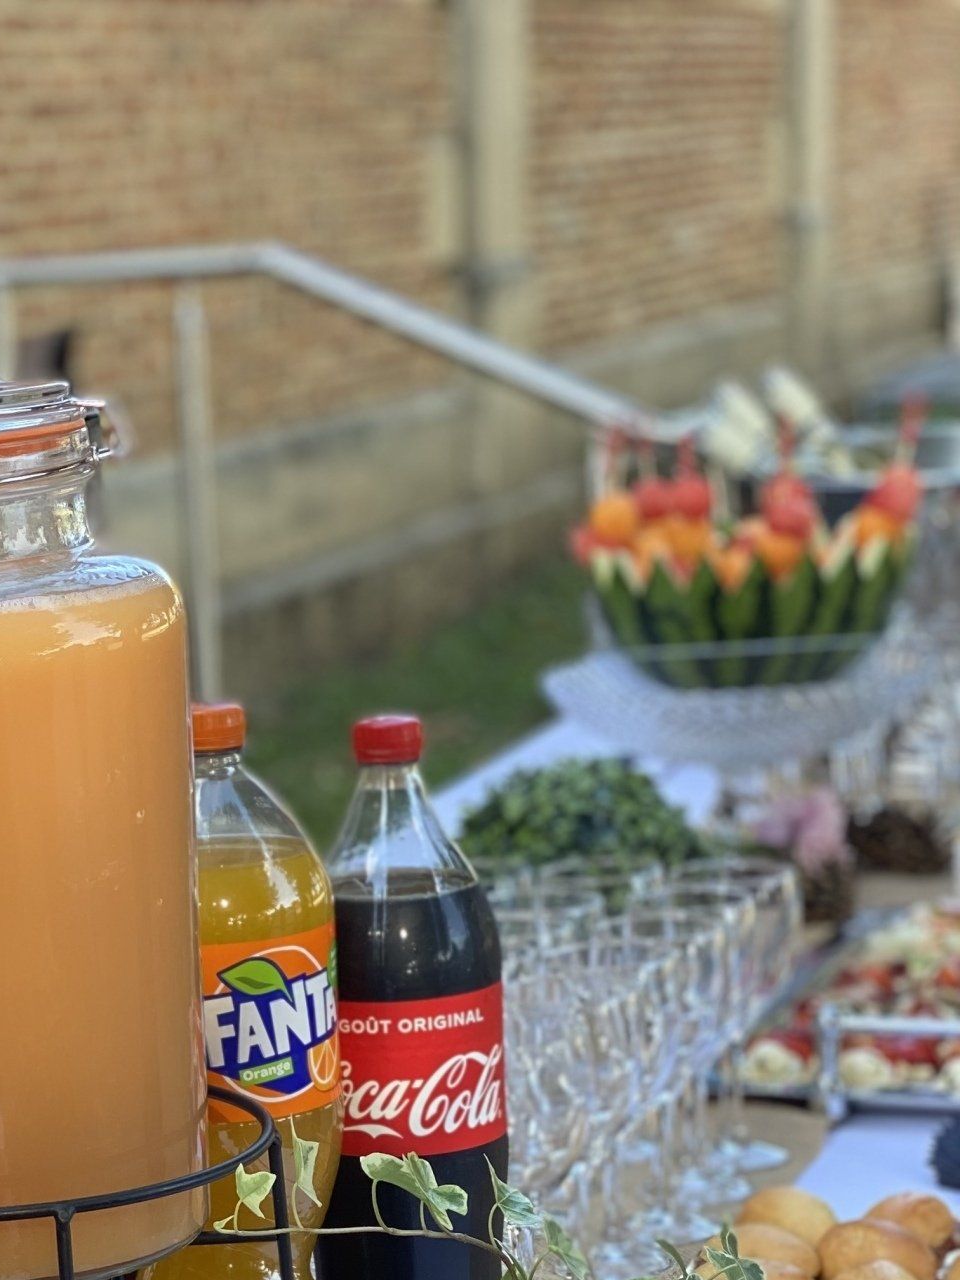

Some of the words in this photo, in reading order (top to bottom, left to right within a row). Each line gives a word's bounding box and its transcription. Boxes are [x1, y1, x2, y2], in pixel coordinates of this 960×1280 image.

[203, 971, 337, 1068] FANTA
[397, 1008, 484, 1033] ORIGINAL
[243, 1062, 292, 1082] Orange
